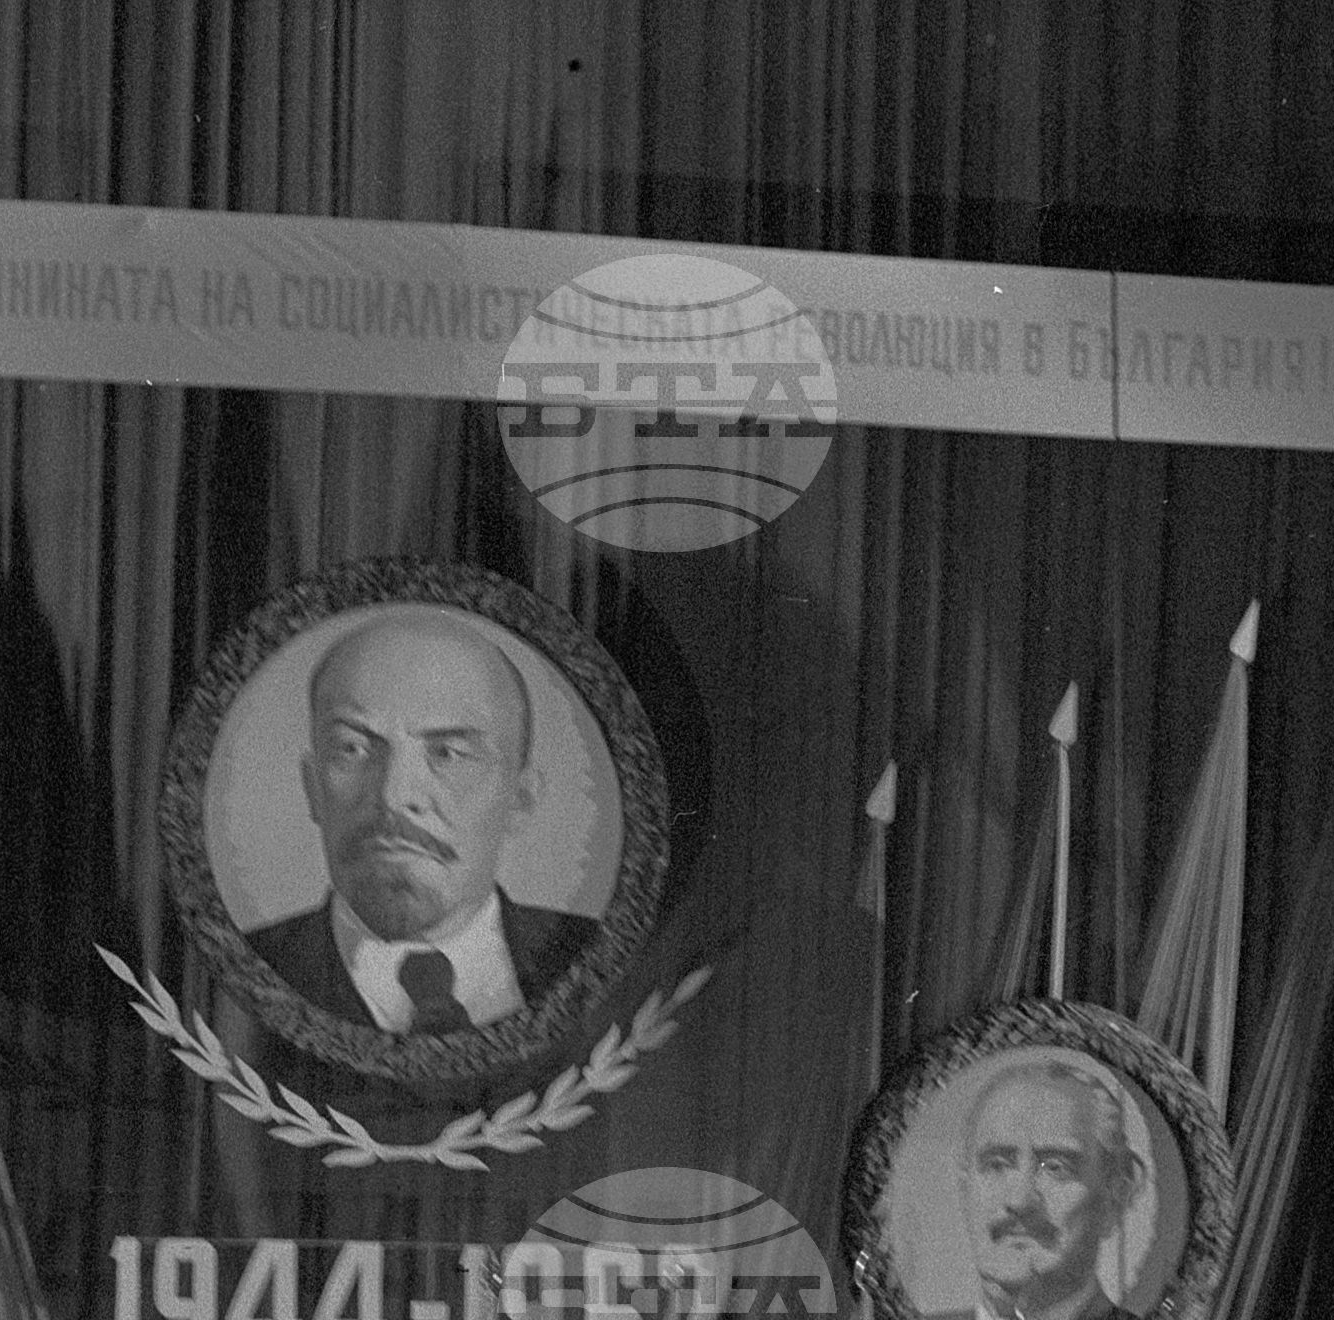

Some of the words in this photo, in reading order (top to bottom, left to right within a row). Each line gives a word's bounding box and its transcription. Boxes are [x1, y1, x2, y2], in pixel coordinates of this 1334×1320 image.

[200, 267, 257, 329] НА
[766, 303, 1001, 378] РЕВОЛЮЦИЯ
[1022, 321, 1046, 377] В
